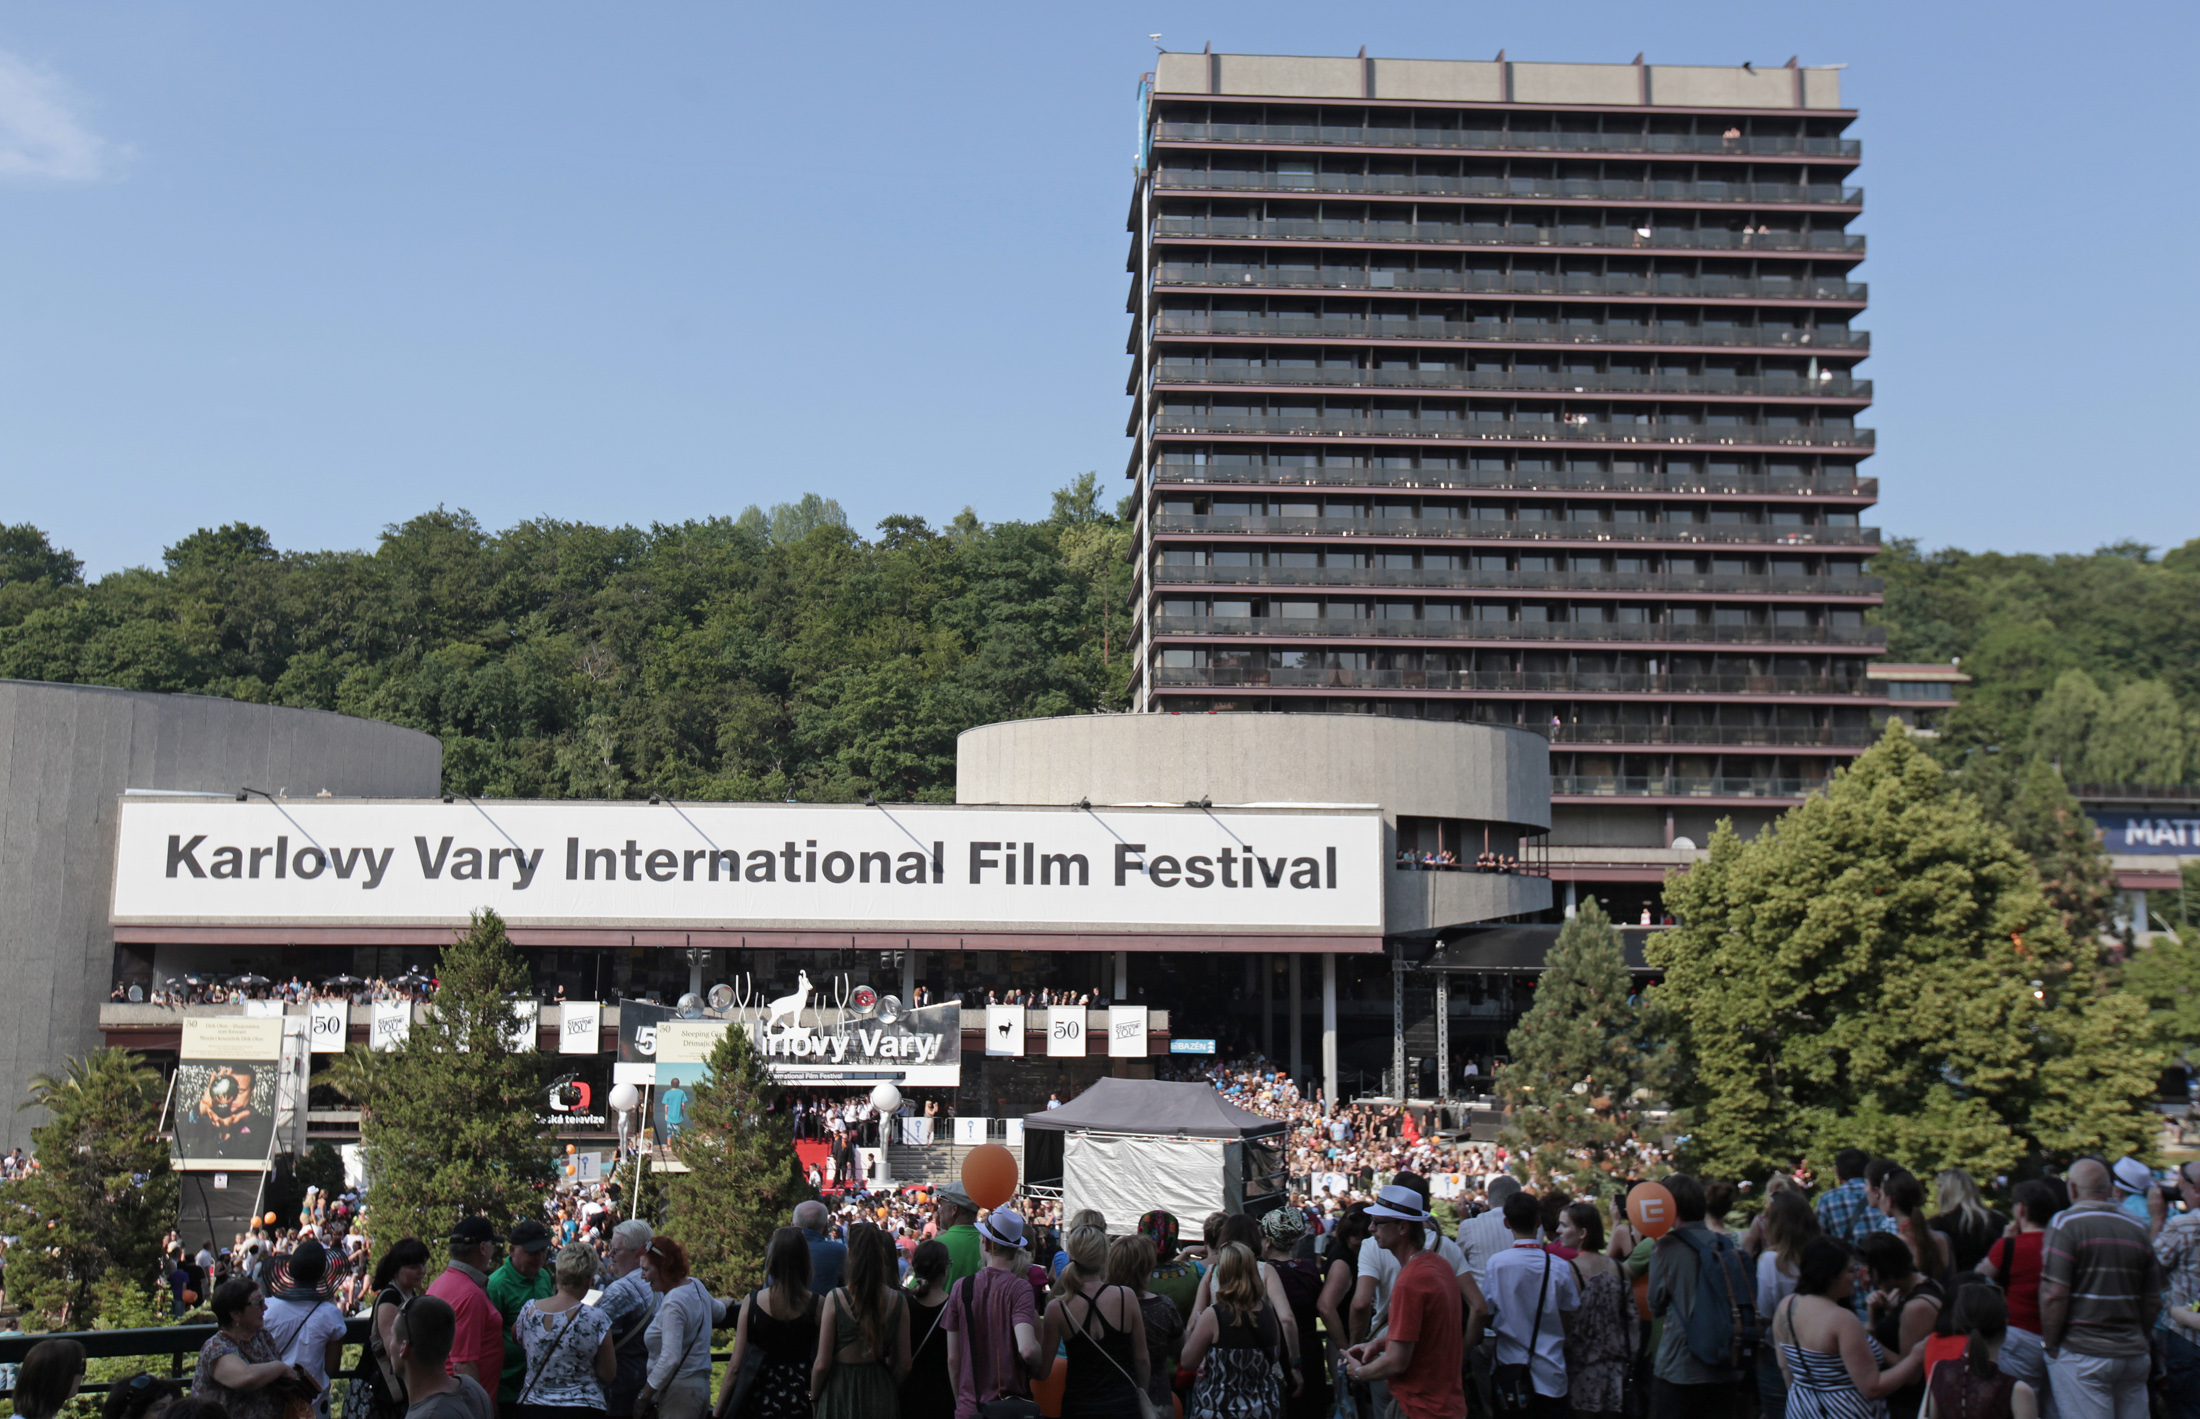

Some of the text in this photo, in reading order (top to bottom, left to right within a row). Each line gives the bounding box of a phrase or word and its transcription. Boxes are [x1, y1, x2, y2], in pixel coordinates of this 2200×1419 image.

[166, 835, 1338, 891] Karlovy Vary International Film Festival
[314, 1016, 340, 1034] 50
[378, 1023, 398, 1034] YOU
[567, 1024, 588, 1035] YOU
[659, 1025, 671, 1033] 50
[1053, 1020, 1079, 1039] 50
[681, 1030, 727, 1039] Sleeping Gian
[1115, 1027, 1136, 1038] YOU
[762, 1029, 938, 1063] rlovy Vary
[1178, 1041, 1207, 1050] BAZÉN
